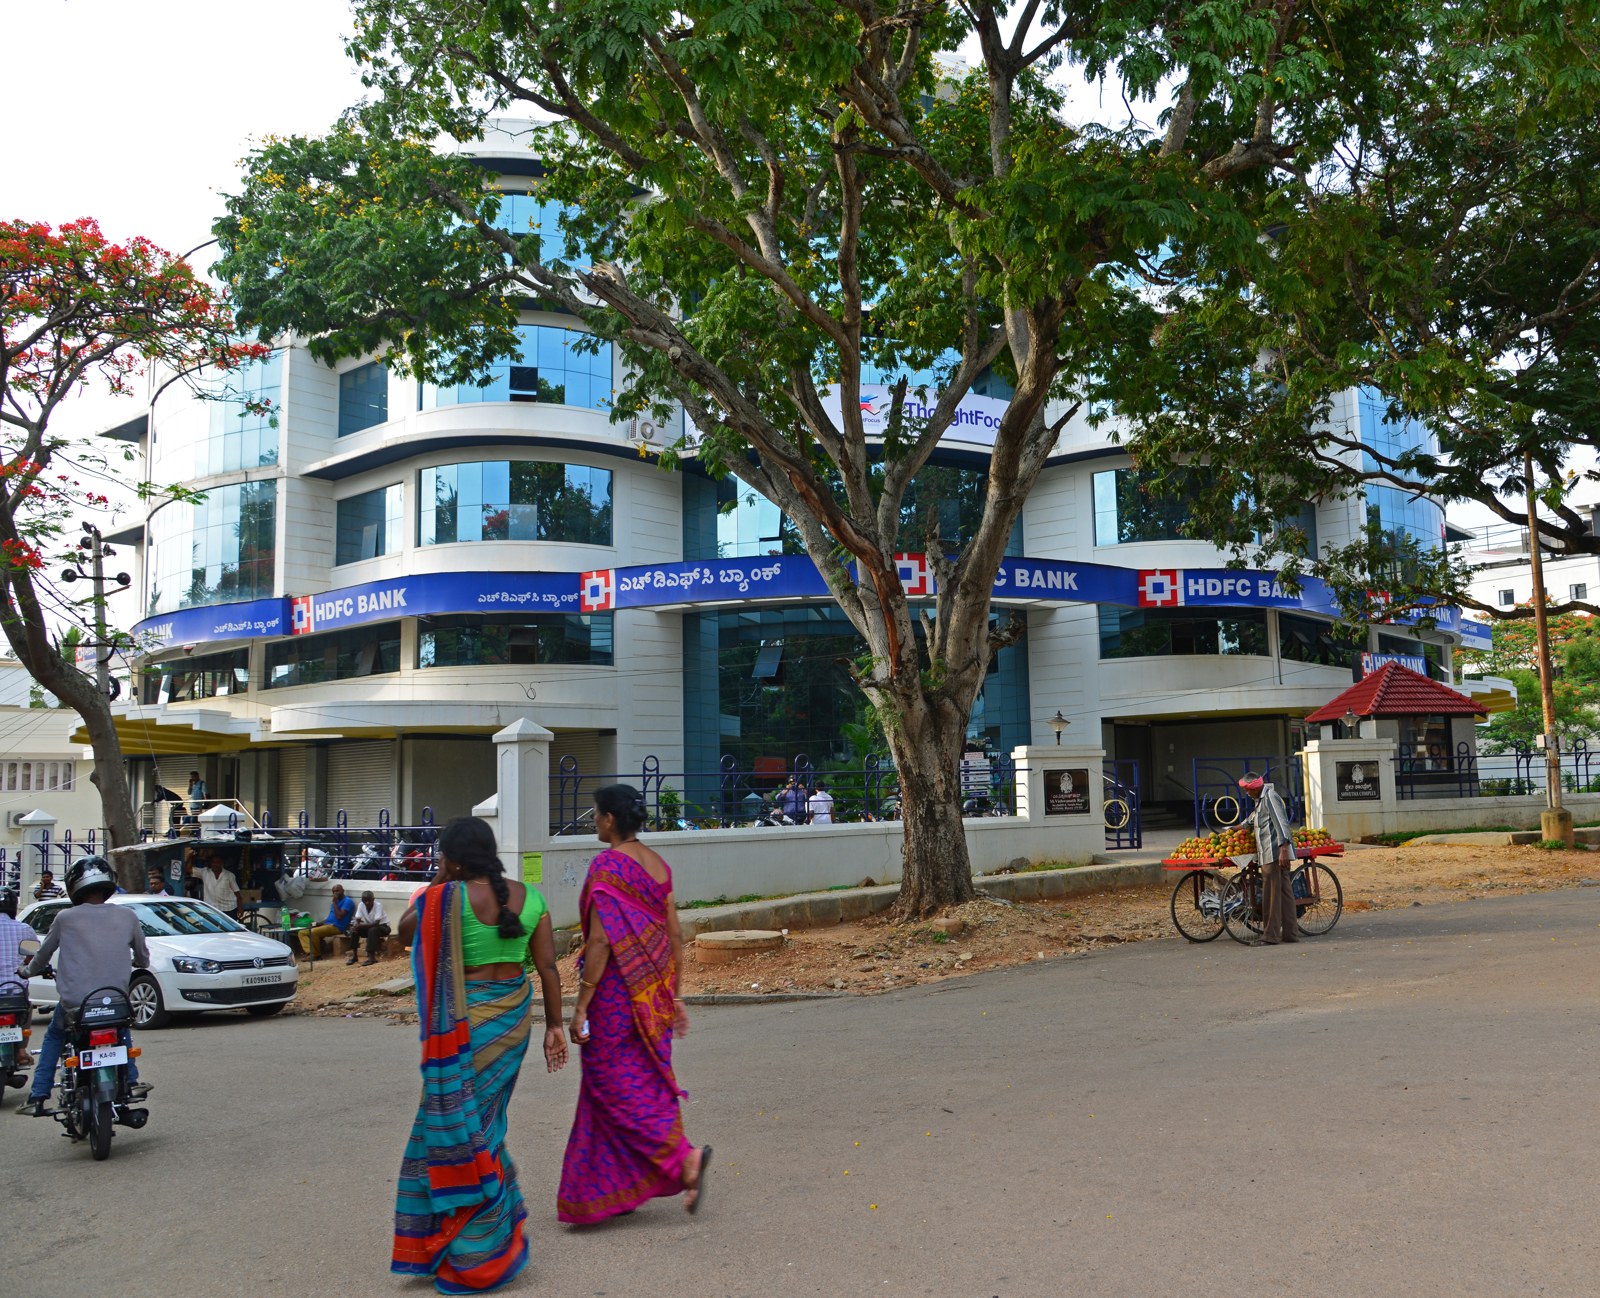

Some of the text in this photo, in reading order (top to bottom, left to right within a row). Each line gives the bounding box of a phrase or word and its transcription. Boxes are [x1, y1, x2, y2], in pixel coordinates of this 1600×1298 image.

[719, 562, 781, 592] ಬ್ಯಾಂಕ್
[1015, 568, 1078, 591] BANK
[1188, 578, 1251, 597] HDFC
[315, 587, 408, 622] HDFC BANK
